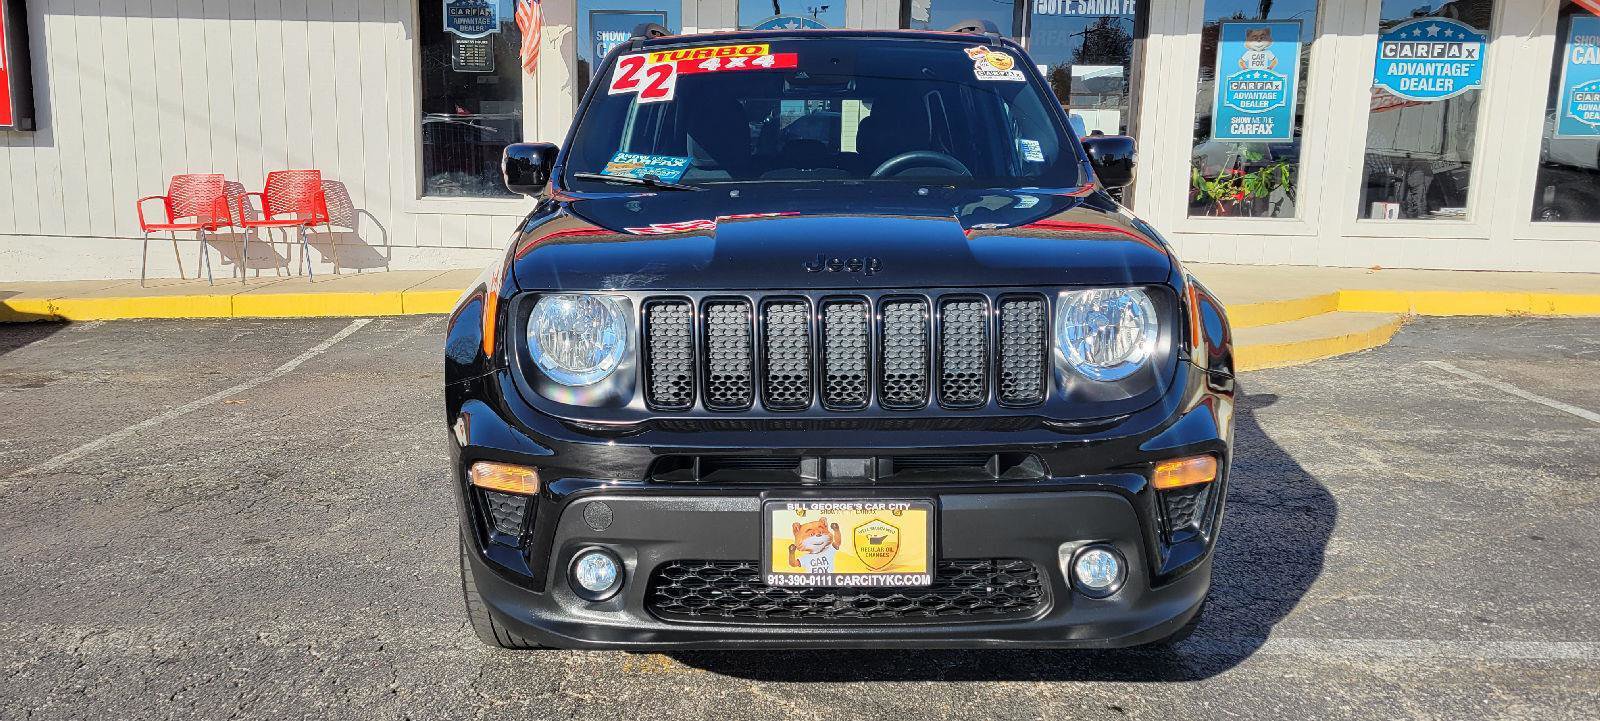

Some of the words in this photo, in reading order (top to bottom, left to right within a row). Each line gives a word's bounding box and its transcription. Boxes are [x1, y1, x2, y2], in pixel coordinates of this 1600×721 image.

[596, 30, 625, 41] SHOW
[653, 46, 765, 63] TURBO
[1383, 43, 1478, 59] CARFAX
[1387, 63, 1470, 77] ADVANTAGE
[1400, 78, 1454, 91] DEALER
[1233, 92, 1277, 100] ADVANTAGE
[1240, 100, 1269, 108] DEALER
[1231, 124, 1273, 134] CARFAX
[805, 253, 882, 277] Jeep
[787, 503, 807, 511] BILL
[811, 503, 863, 511] GEORGE'S
[865, 503, 886, 511] CAR
[888, 503, 911, 511] CITY
[810, 556, 829, 567] CAR
[767, 575, 833, 586] 913-390-0111
[835, 575, 931, 586] CARCITYKC.COM
